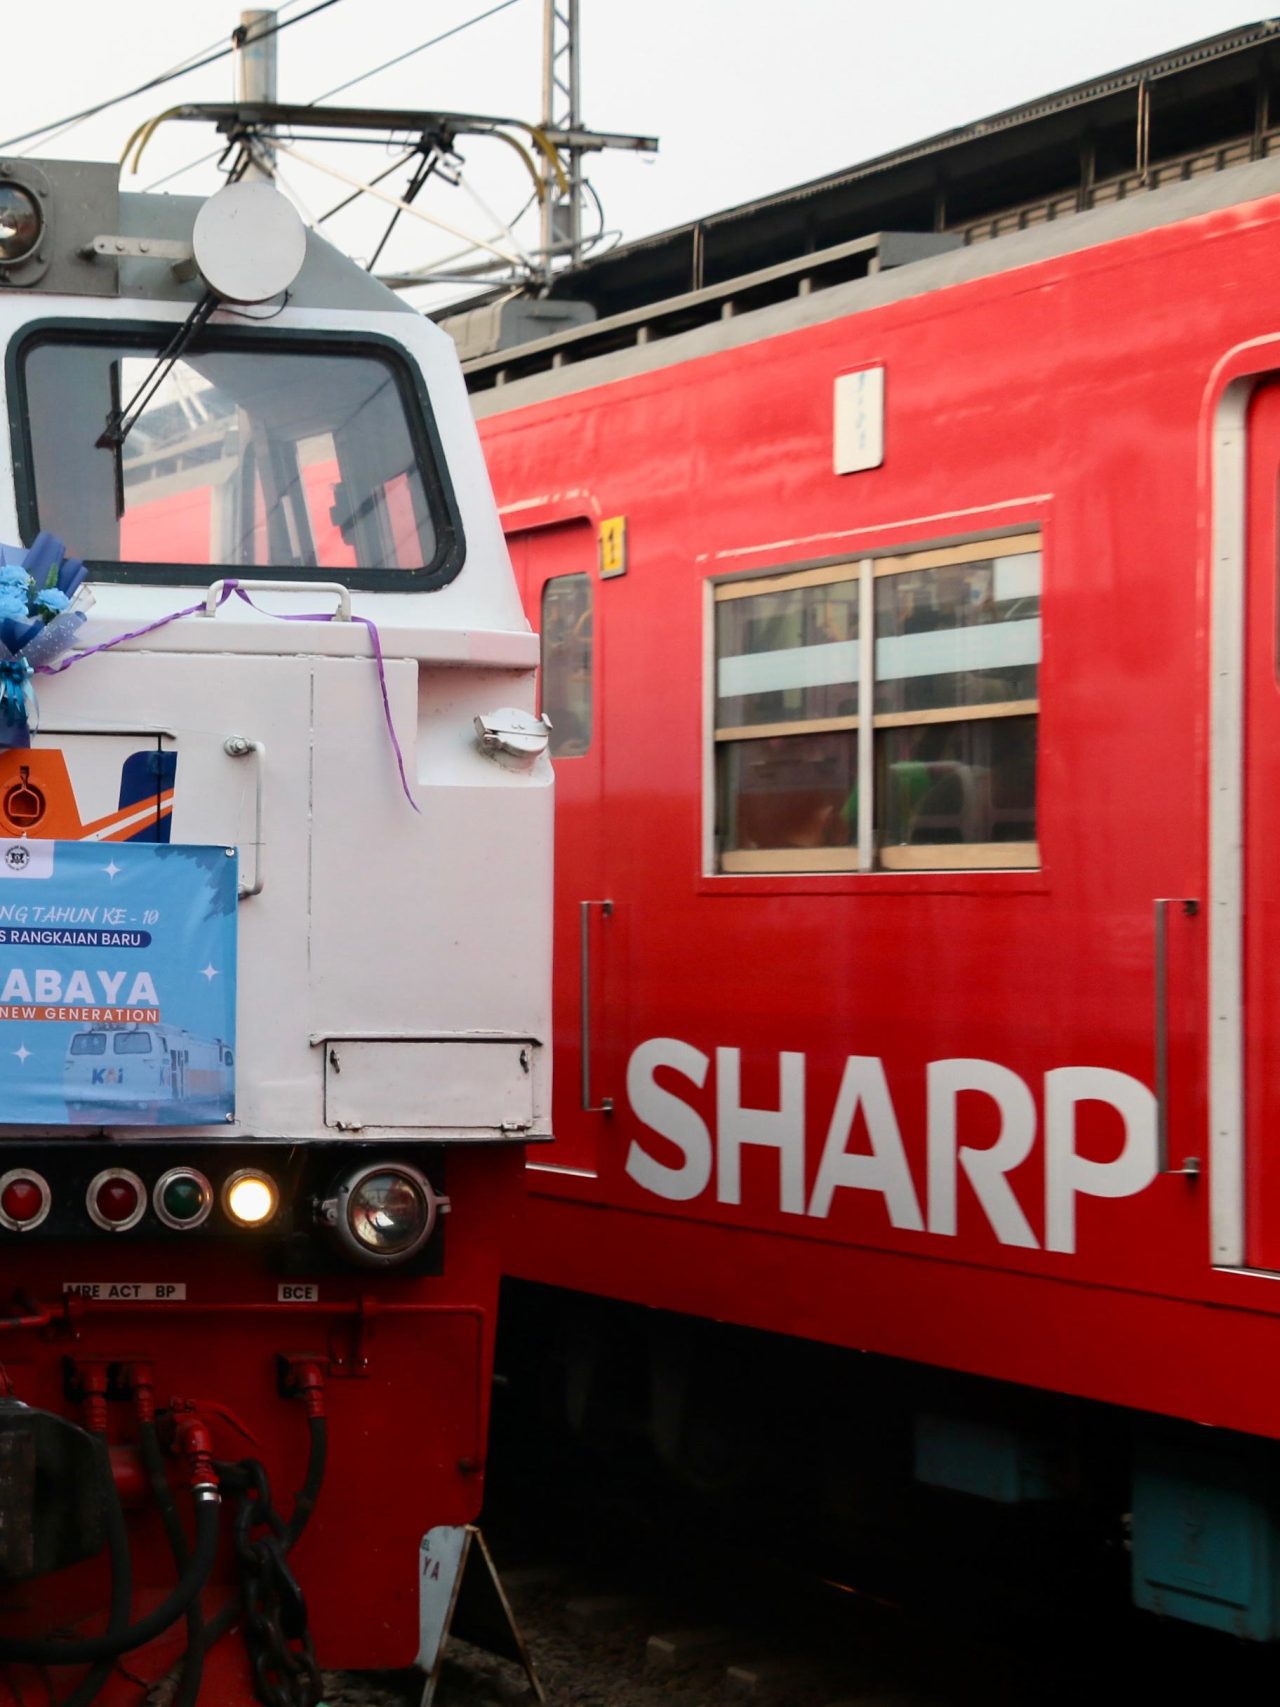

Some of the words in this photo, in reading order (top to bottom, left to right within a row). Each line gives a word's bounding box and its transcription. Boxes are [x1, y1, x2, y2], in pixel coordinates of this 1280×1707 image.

[32, 905, 99, 924] TAHUN
[102, 907, 127, 925] KE
[10, 930, 98, 945] RANGKAIAN
[101, 932, 141, 946] BARU
[44, 1008, 157, 1022] GENERATION
[625, 1037, 1158, 1254] SHARP
[108, 1285, 141, 1298] ACT
[155, 1285, 176, 1298] BP
[282, 1286, 313, 1300] BCE
